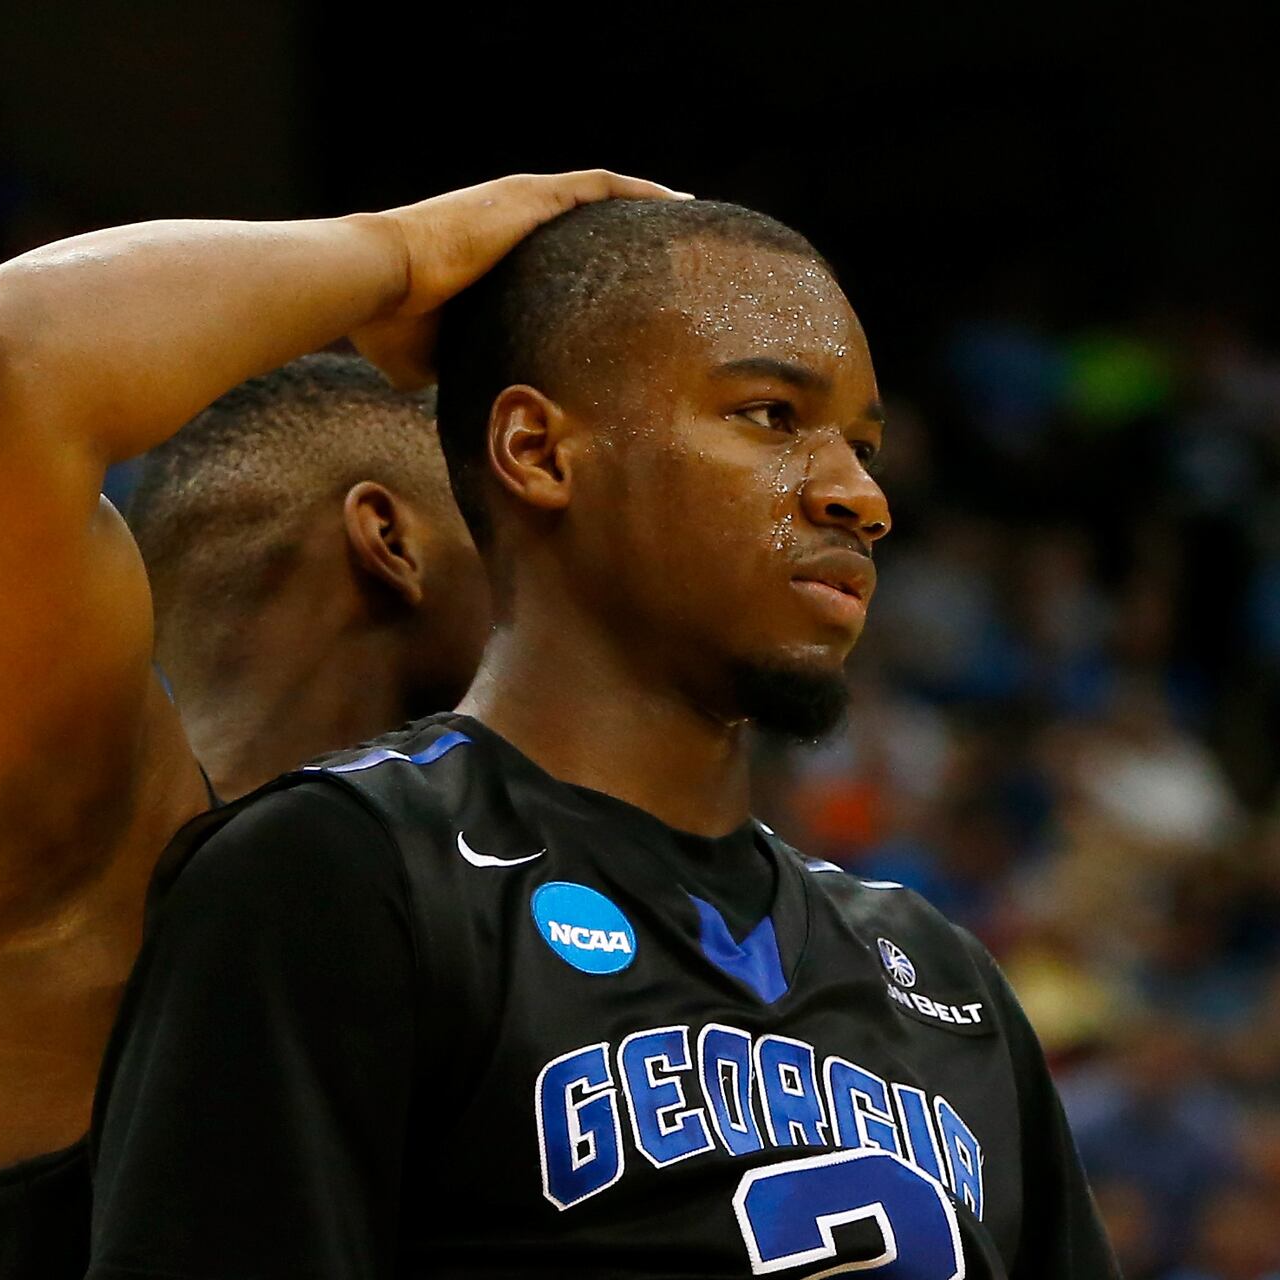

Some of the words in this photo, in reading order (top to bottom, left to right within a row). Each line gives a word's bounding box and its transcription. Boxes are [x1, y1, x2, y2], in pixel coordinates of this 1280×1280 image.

[549, 921, 632, 954] NCAA
[909, 992, 983, 1025] BELT
[534, 1022, 985, 1223] GEORGIA
